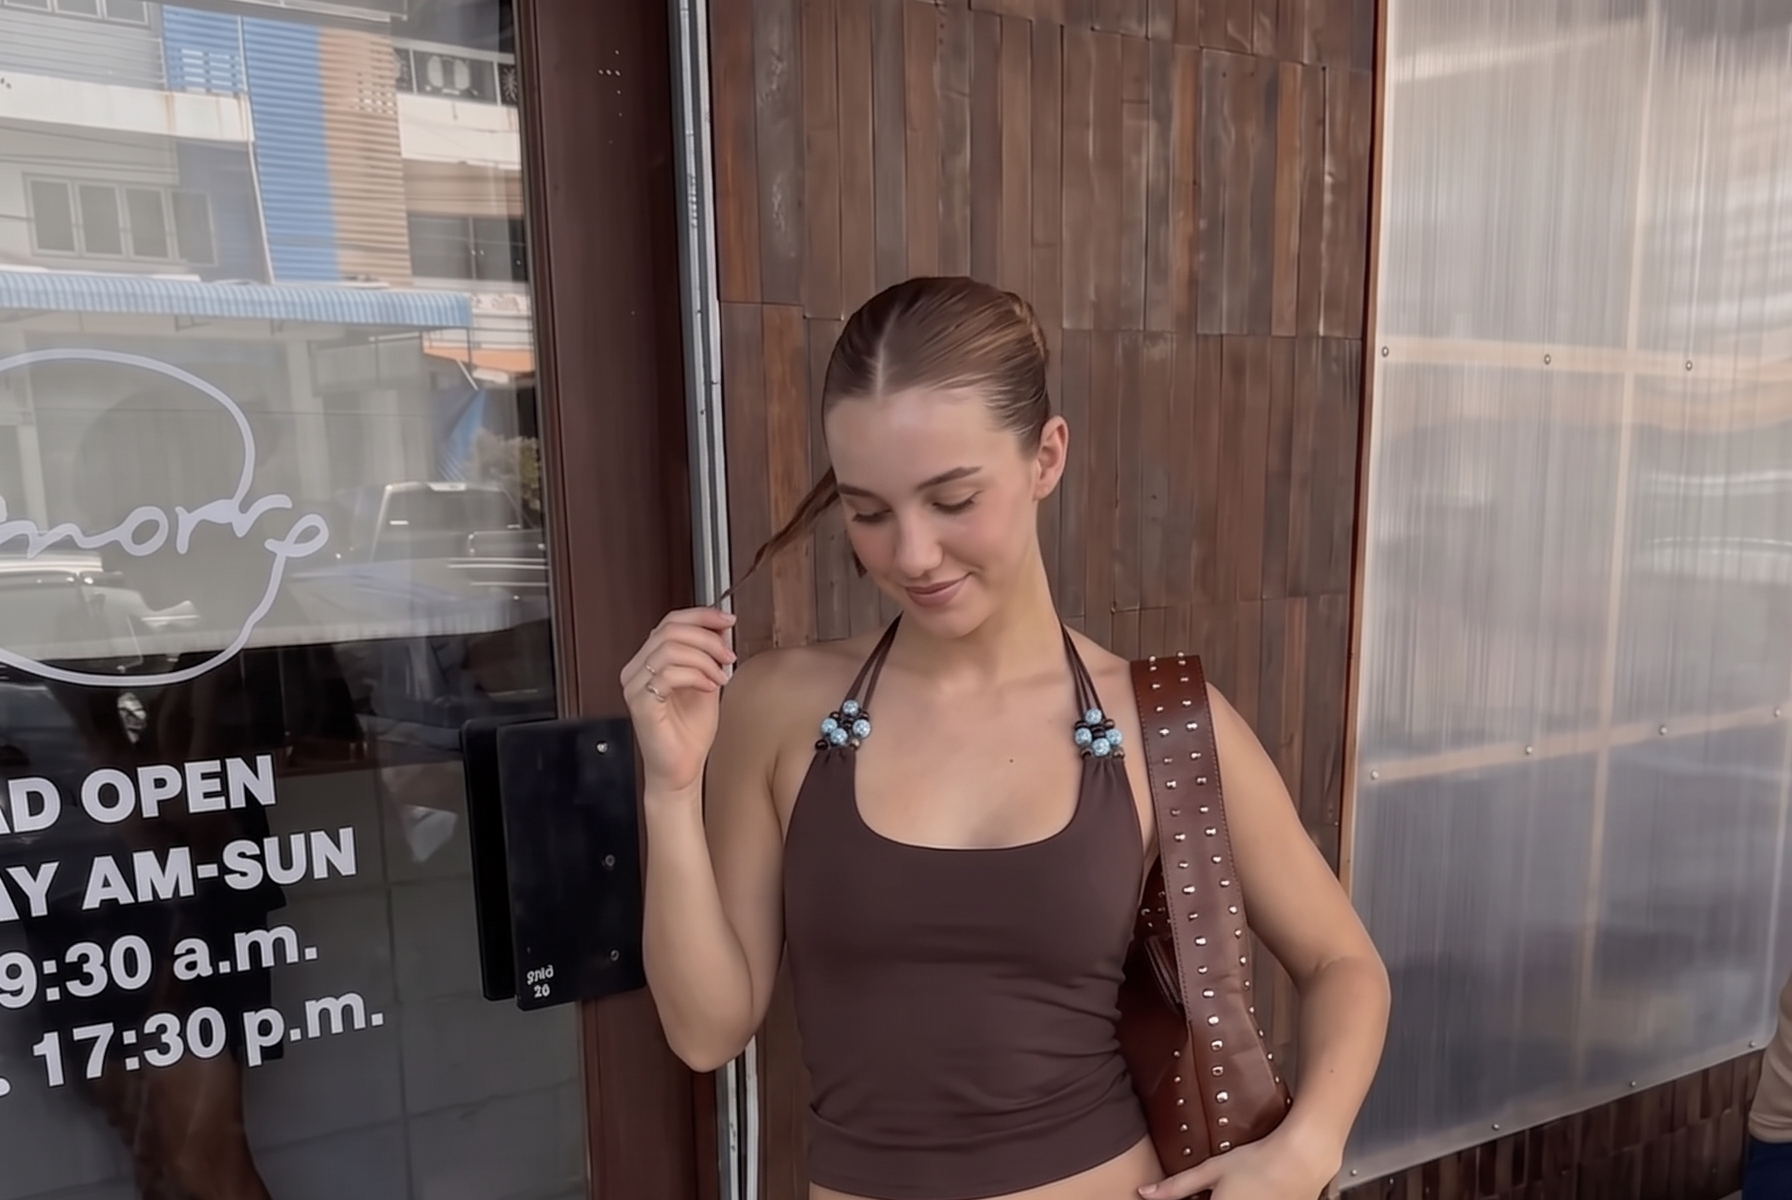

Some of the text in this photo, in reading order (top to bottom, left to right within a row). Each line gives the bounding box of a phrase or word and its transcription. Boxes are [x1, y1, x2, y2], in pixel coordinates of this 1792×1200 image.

[82, 754, 276, 823] OPEN
[82, 826, 357, 910] AM-SUN
[0, 925, 318, 1009] 9:30 a.m.
[33, 992, 384, 1087] 17:30 p.m.
